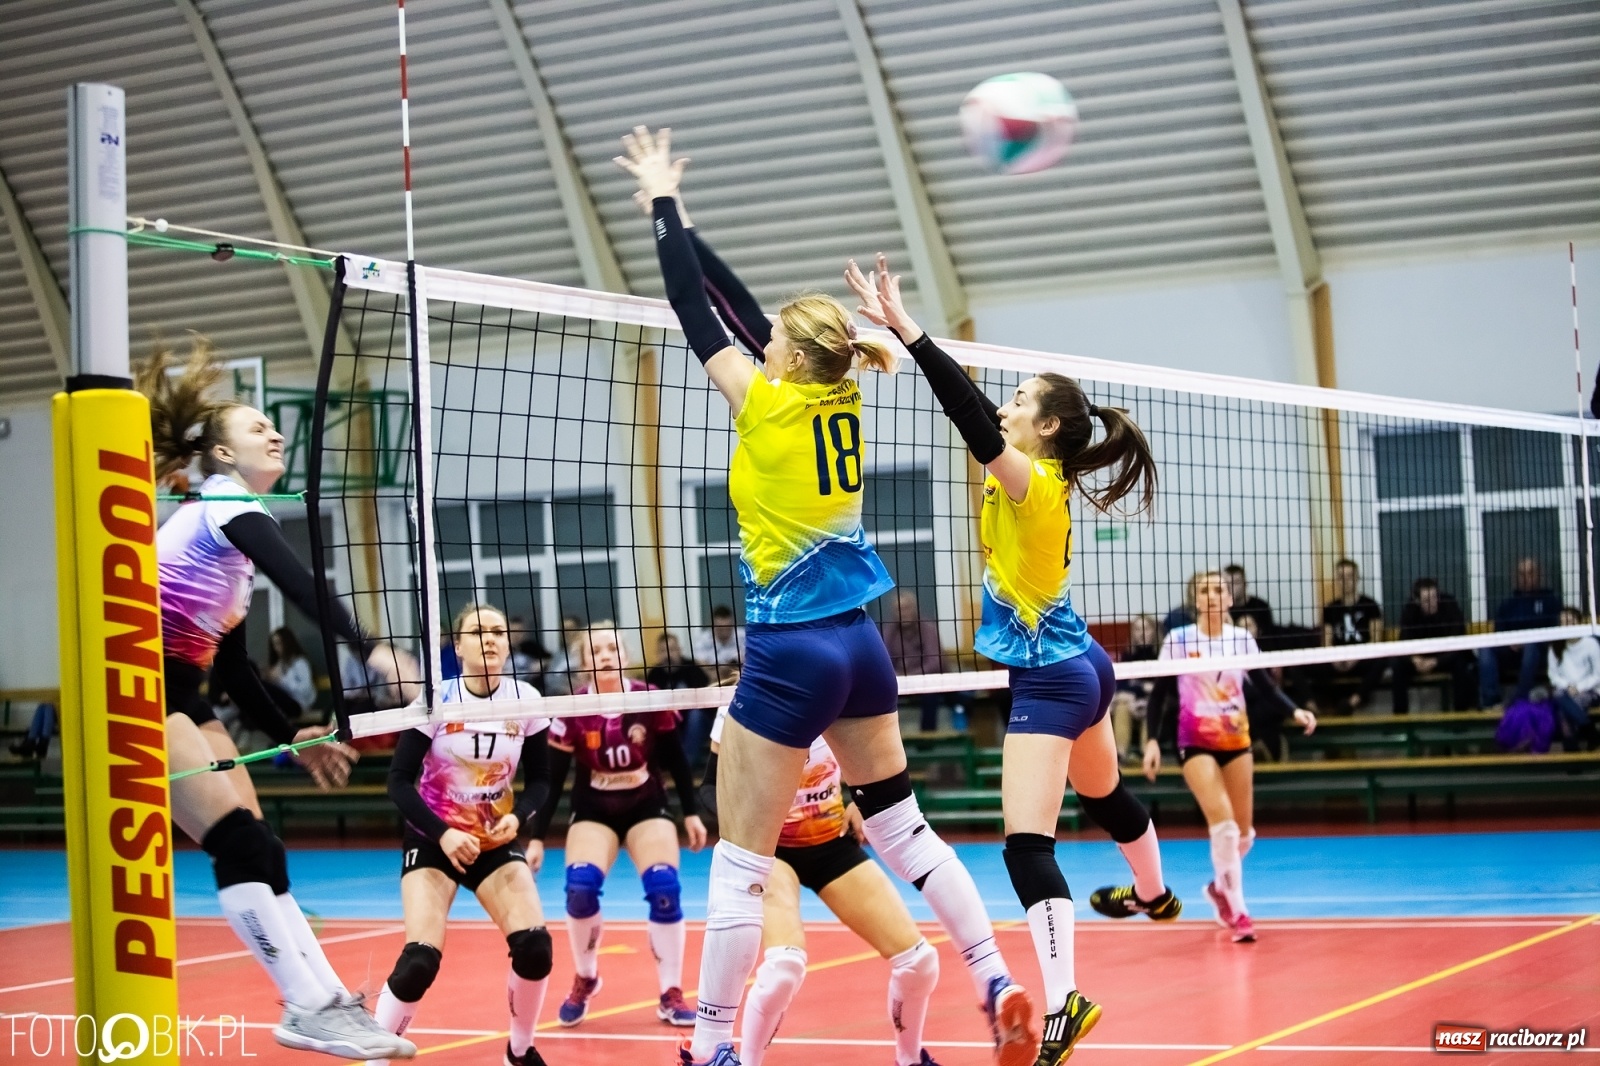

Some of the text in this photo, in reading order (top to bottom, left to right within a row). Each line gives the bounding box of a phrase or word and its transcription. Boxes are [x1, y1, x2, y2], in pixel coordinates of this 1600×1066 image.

[812, 412, 862, 496] 18
[98, 440, 174, 980] PESMENPOL
[471, 732, 497, 760] 17
[605, 744, 631, 769] 10
[405, 848, 419, 867] 17
[1047, 914, 1058, 960] CENTRUM
